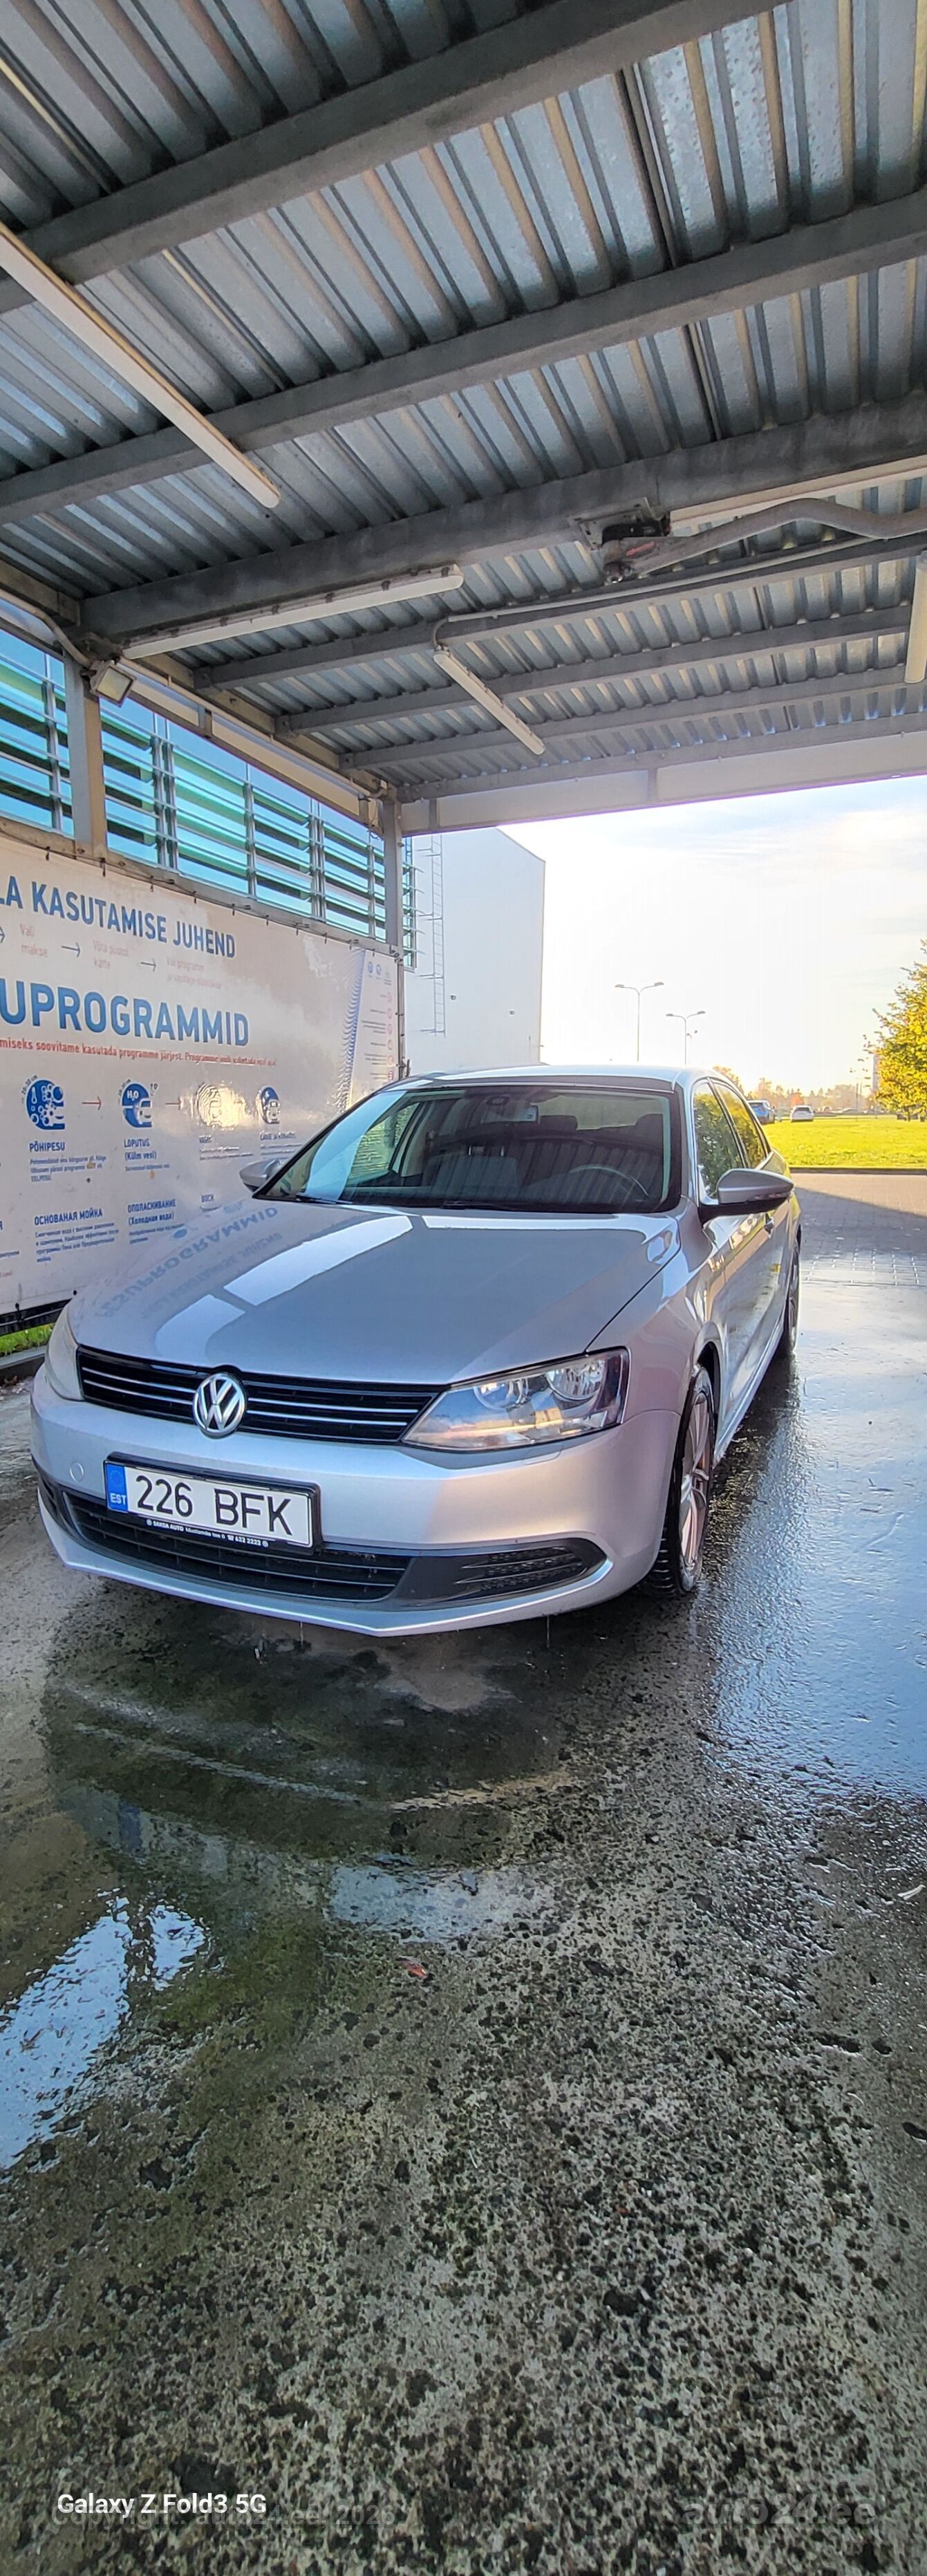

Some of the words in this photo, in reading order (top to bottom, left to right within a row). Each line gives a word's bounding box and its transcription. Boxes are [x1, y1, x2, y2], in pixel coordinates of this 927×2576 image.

[31, 881, 167, 943] KASUTAMISE
[174, 921, 236, 959] JUHEND
[0, 978, 250, 1047] UPROGRAMMID
[0, 1037, 33, 1049] miseks
[36, 1041, 79, 1054] soovitame
[82, 1043, 117, 1056] kasutada
[119, 1048, 158, 1060] programme
[29, 1141, 65, 1152] PÕHIPESU
[124, 1138, 150, 1148] LOPUTUS
[35, 1211, 77, 1226] ОСНОВАНАЯ
[79, 1207, 103, 1220] МОЙКА
[110, 1493, 126, 1506] EST
[136, 1475, 193, 1518] 226
[214, 1488, 292, 1536] BFK
[170, 1524, 184, 1532] AUTO
